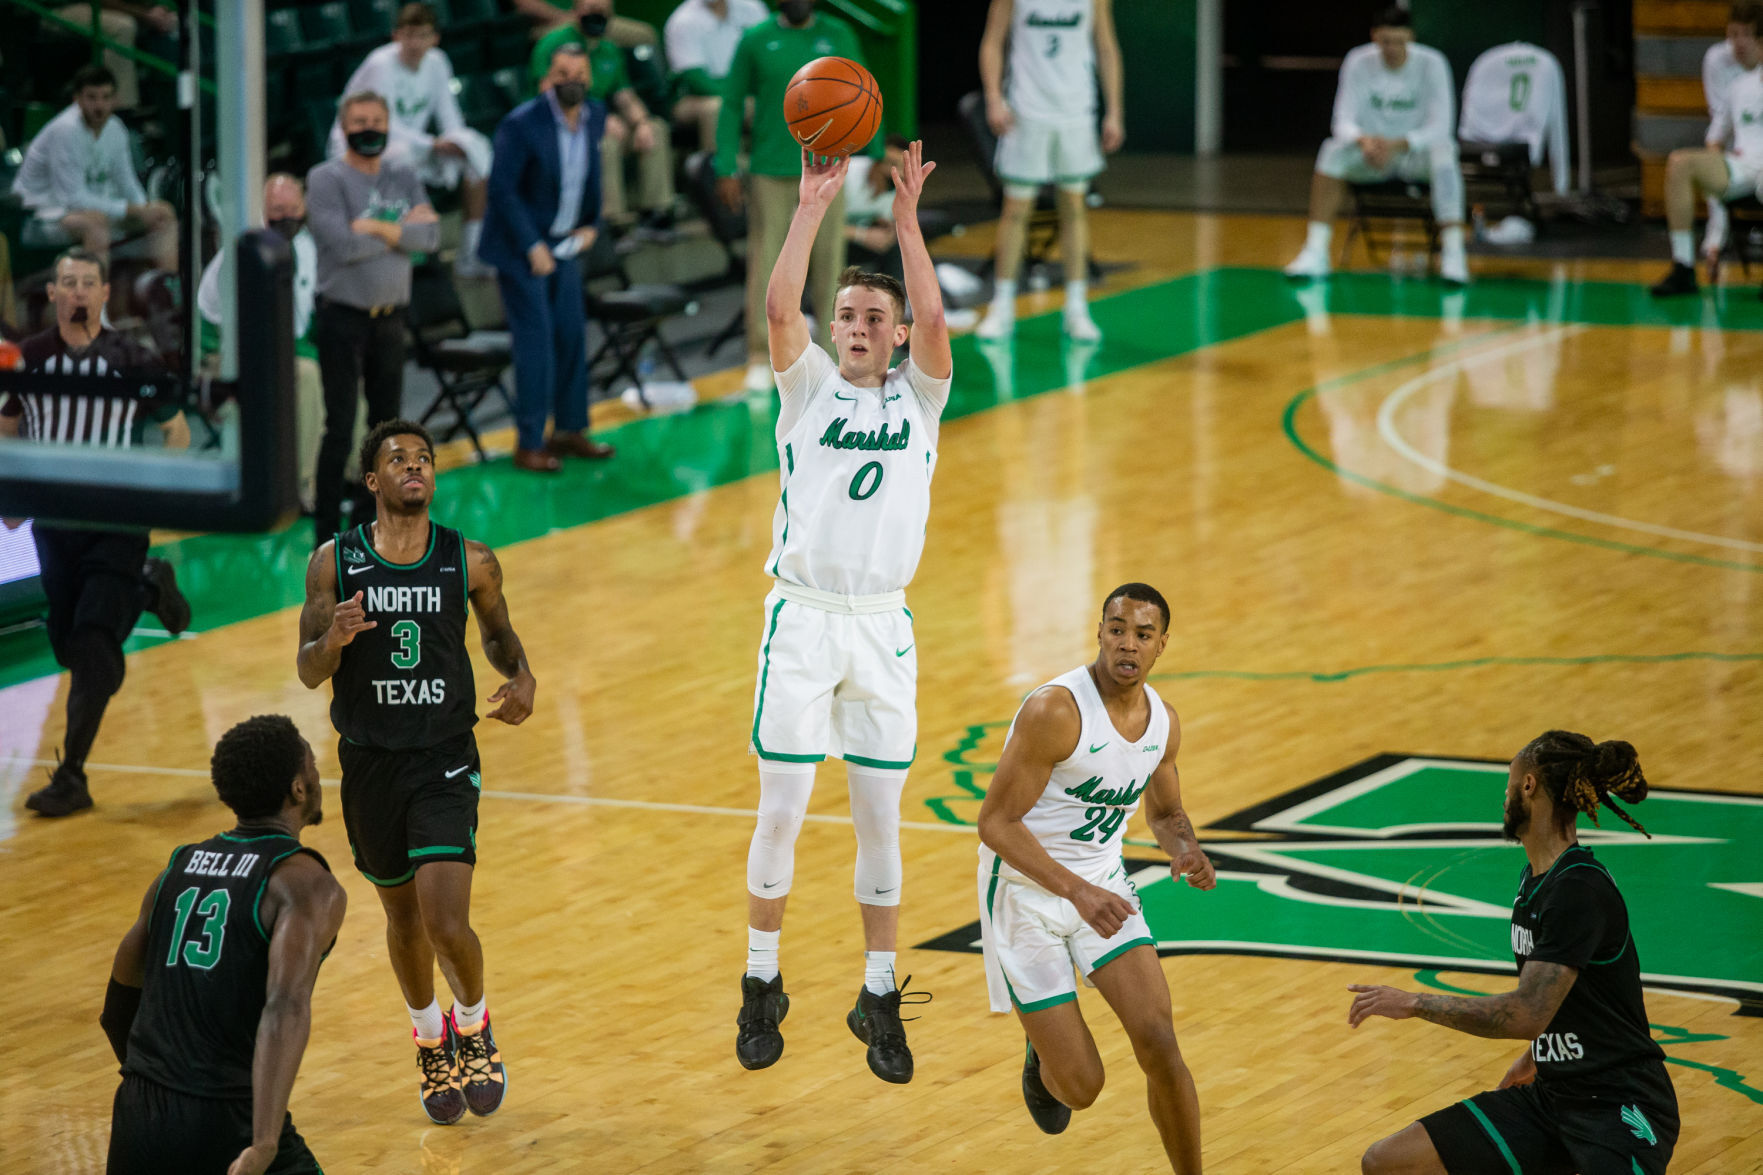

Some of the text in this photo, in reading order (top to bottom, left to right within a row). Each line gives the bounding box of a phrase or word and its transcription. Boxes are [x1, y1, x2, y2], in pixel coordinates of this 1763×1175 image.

[1509, 72, 1531, 112] 0
[848, 460, 884, 501] 0
[367, 586, 441, 613] NORTH
[391, 619, 421, 669] 3
[372, 678, 446, 705] TEXAS
[1069, 806, 1126, 844] 24
[184, 850, 260, 878] BELL III
[166, 886, 231, 970] 13
